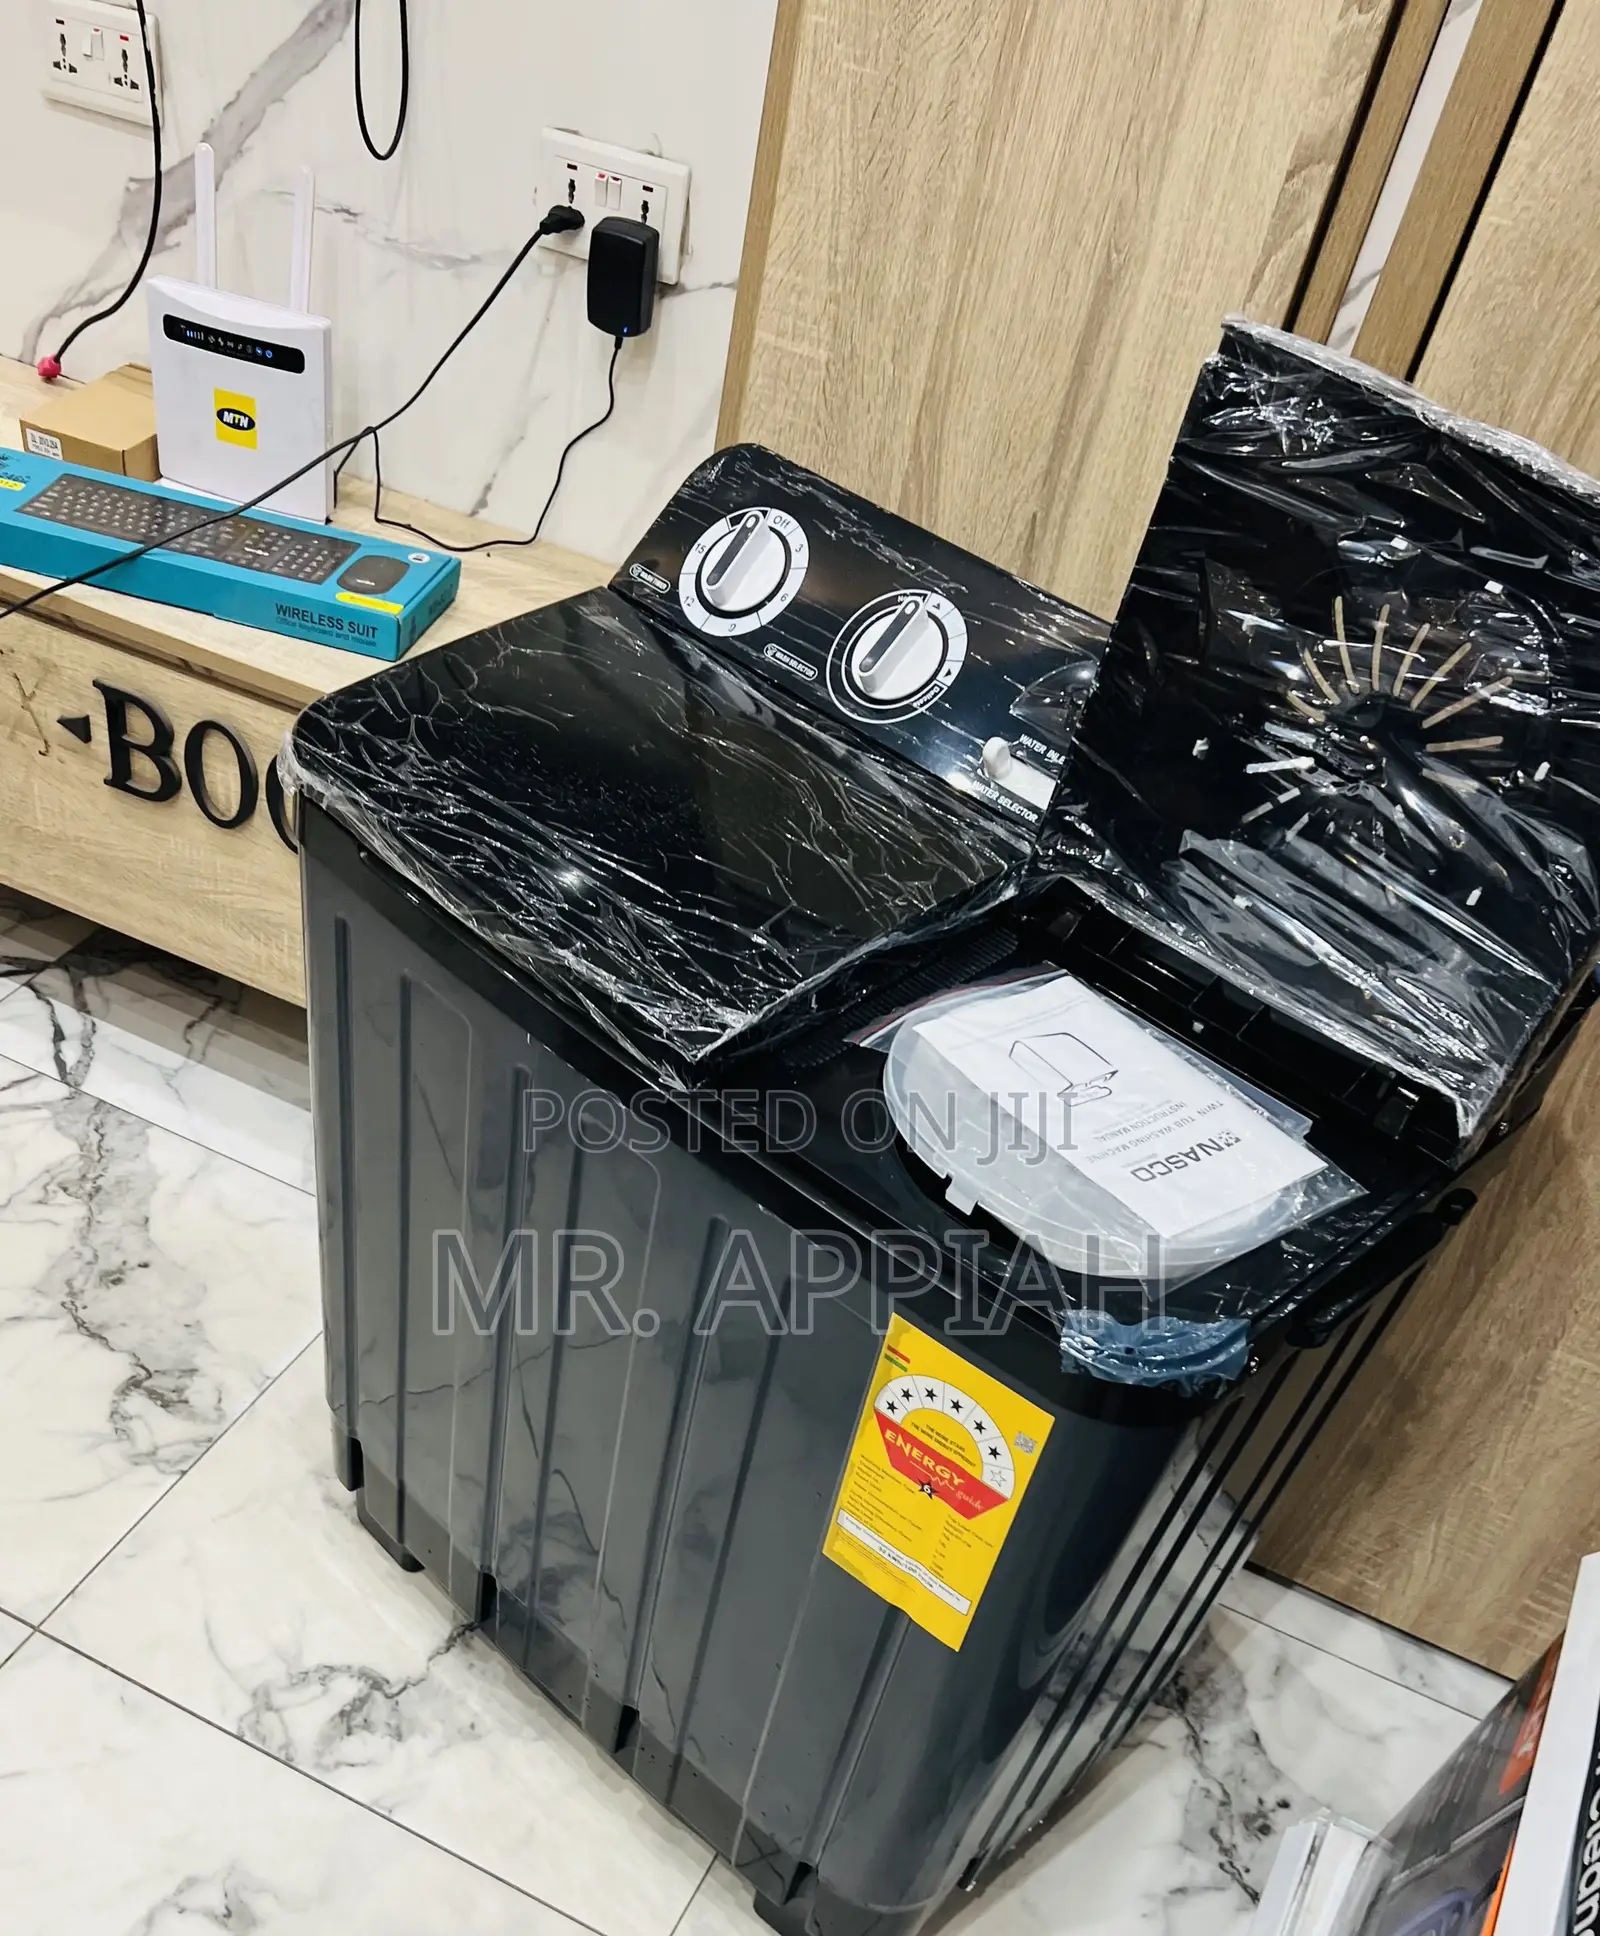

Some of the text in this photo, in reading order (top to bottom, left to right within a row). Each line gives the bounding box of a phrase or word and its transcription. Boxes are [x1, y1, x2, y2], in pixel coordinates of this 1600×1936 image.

[222, 410, 249, 428] MTN
[773, 515, 790, 529] Off
[695, 543, 707, 554] 15
[795, 544, 804, 553] 3
[683, 595, 695, 607] 12
[780, 593, 789, 602] 6
[275, 603, 379, 640] WIRELESS SUIT
[788, 658, 815, 678] SELECTOR
[1019, 734, 1047, 754] WATER
[972, 780, 1039, 823] WATER SELECTOR
[1130, 1101, 1187, 1129] INSTRUCTION
[1197, 1100, 1224, 1117] TWIN
[1175, 1116, 1196, 1129] TUB
[1094, 1125, 1132, 1142] MANUAL
[1129, 1124, 1176, 1147] WASHING
[1085, 1143, 1131, 1164] MACHINE
[1130, 1138, 1225, 1182] NASCO
[885, 1428, 965, 1486] ENERGY
[923, 1484, 932, 1494] 6
